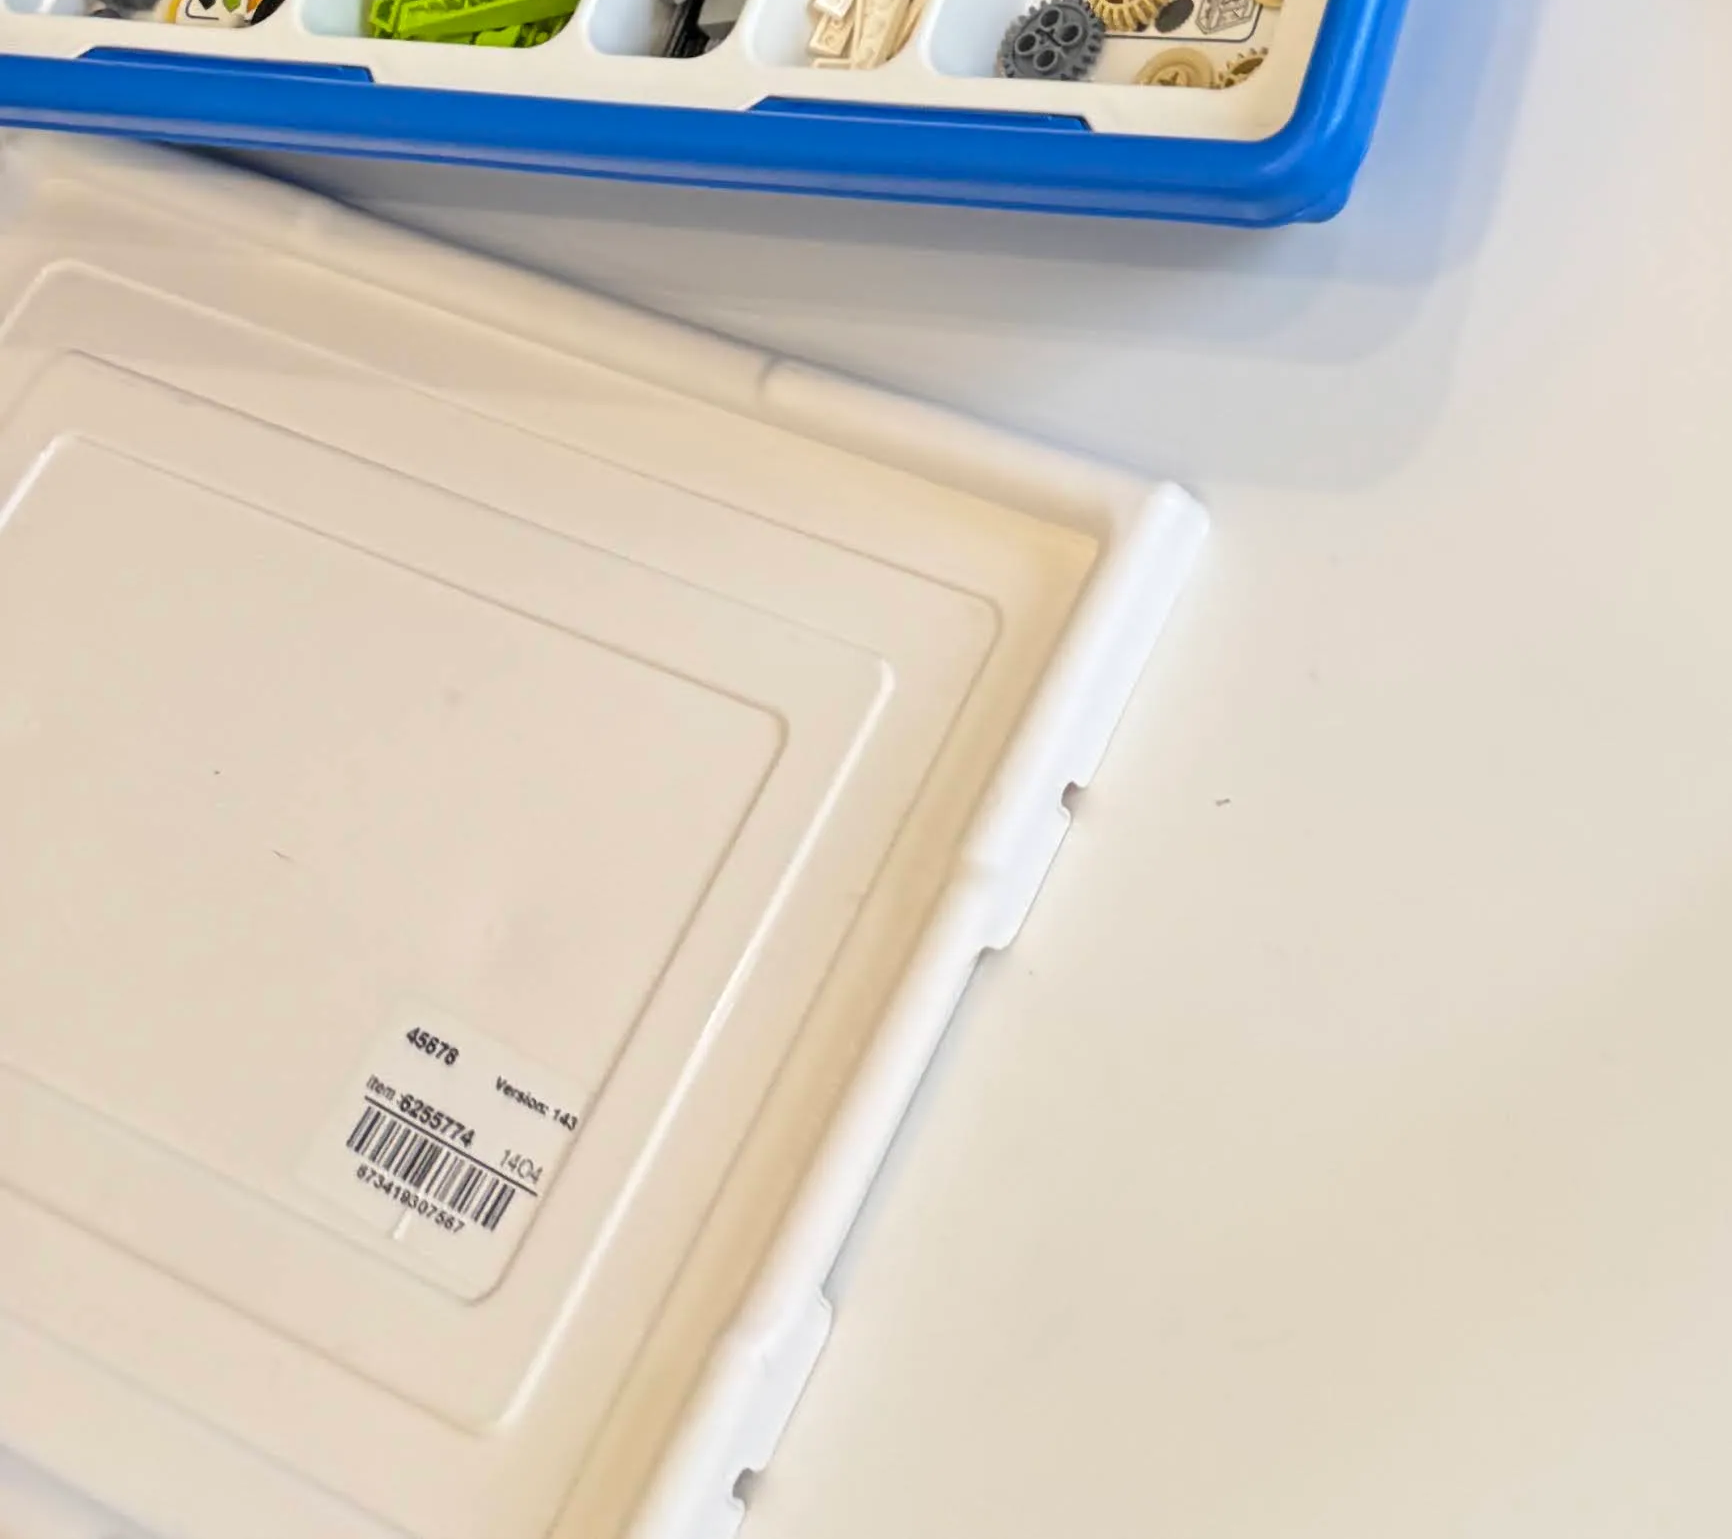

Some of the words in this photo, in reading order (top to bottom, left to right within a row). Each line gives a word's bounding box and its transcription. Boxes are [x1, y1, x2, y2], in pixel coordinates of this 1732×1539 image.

[405, 1026, 460, 1066] 45678
[494, 1075, 550, 1116] Version:
[499, 1149, 543, 1185] 1404
